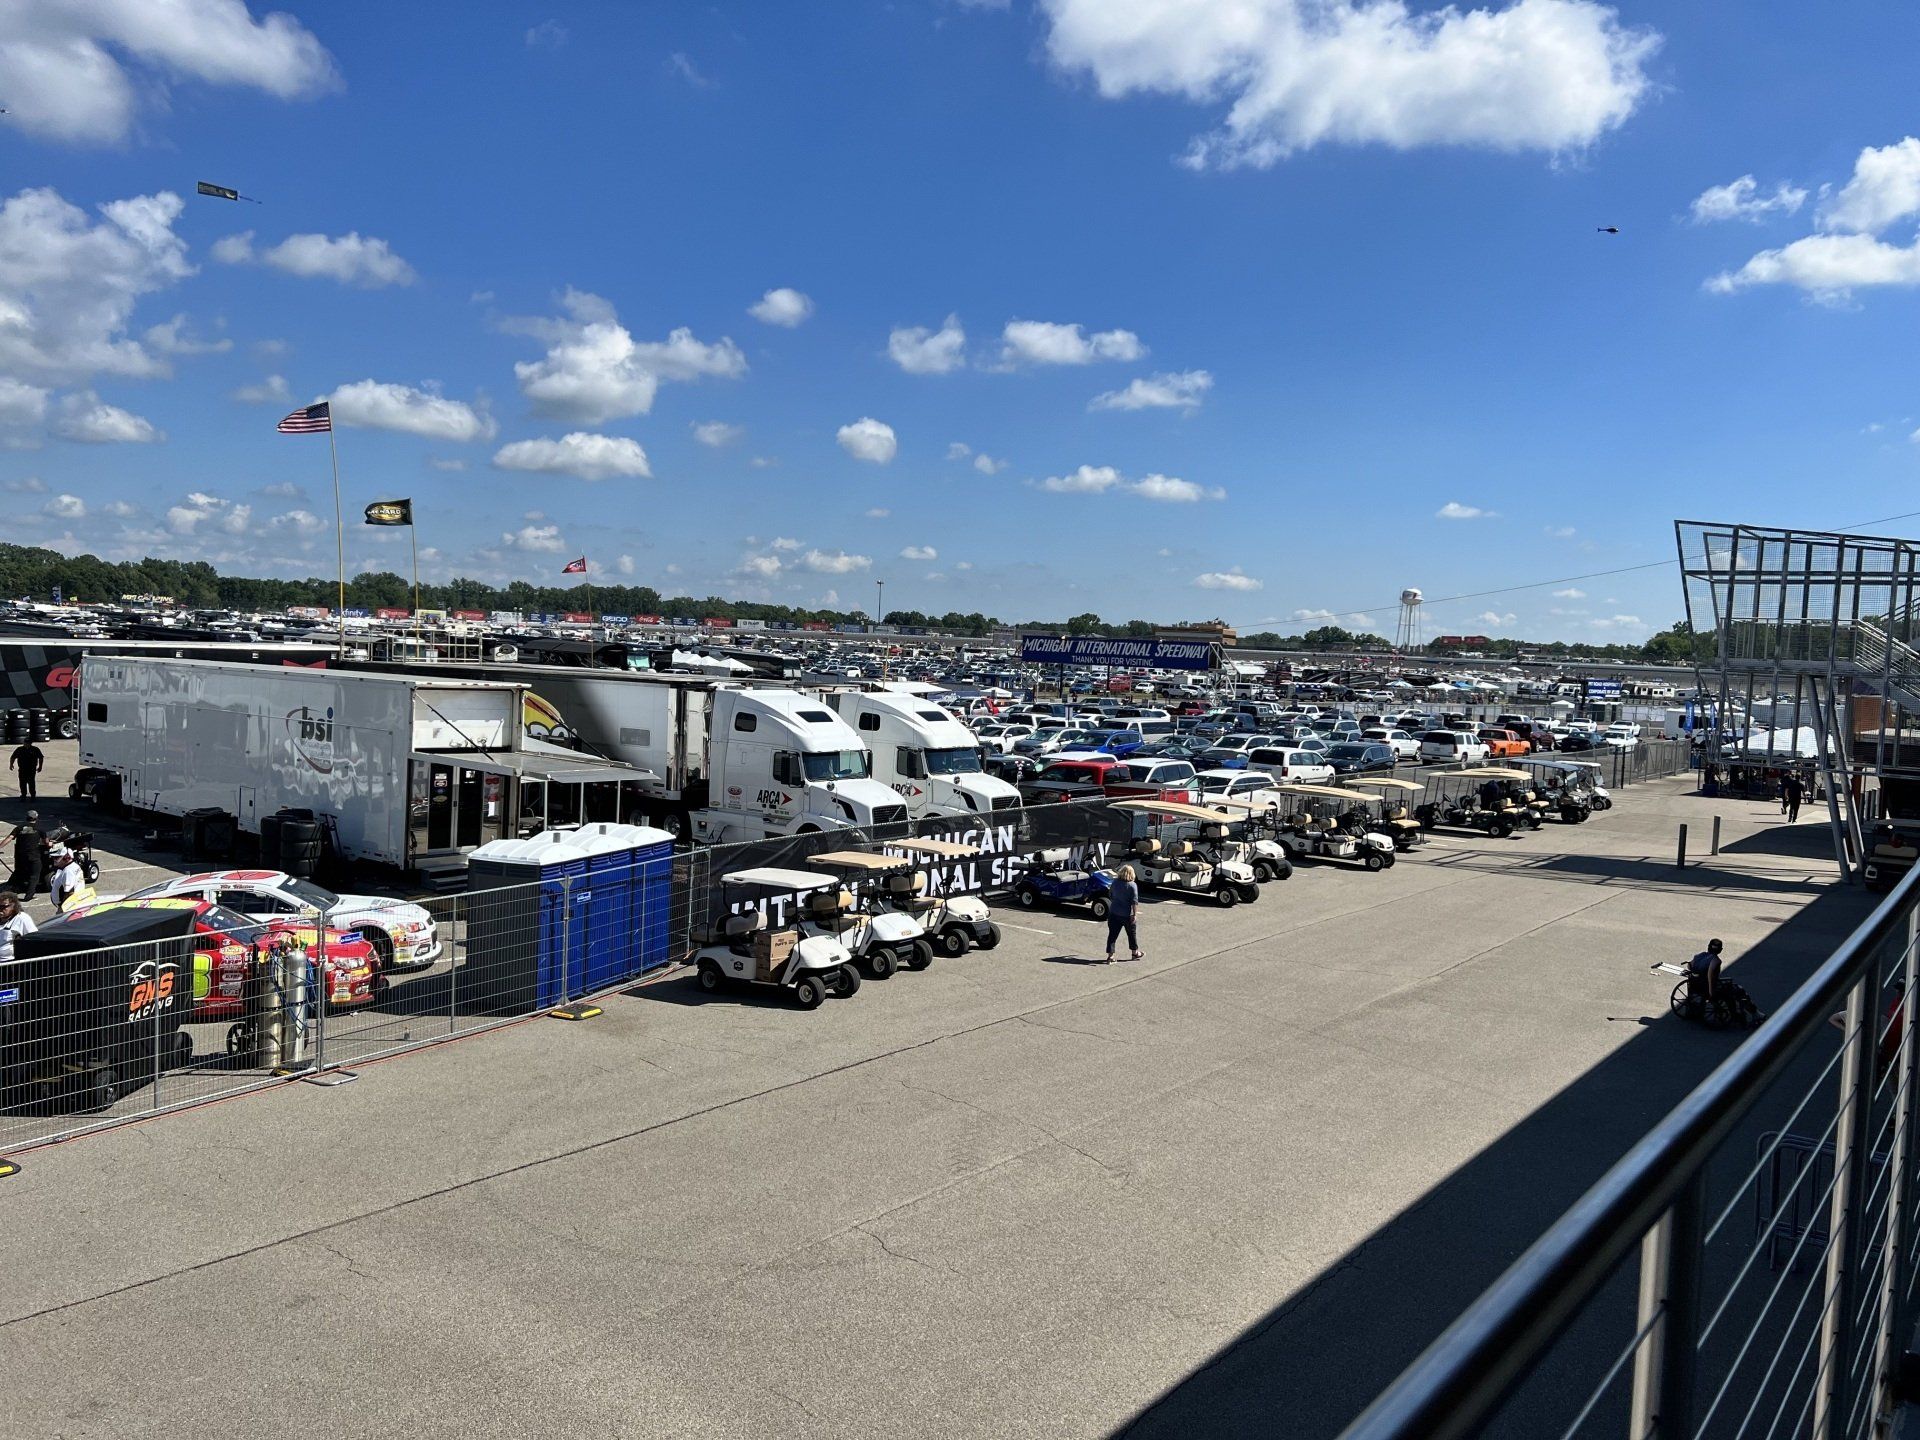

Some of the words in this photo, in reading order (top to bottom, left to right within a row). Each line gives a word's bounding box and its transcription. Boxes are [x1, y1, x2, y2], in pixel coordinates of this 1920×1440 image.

[1023, 638, 1072, 653] MICHIGAN
[1075, 642, 1151, 657] INTERNATIONAL
[1154, 643, 1209, 659] SPEEDWAY
[1072, 655, 1093, 664] THANK
[1095, 657, 1110, 665] YOU
[1110, 658, 1124, 666] FOR
[1125, 658, 1154, 667] VISITING
[301, 706, 334, 743] bsi
[756, 789, 781, 805] ARCA
[129, 971, 174, 1011] GMS
[128, 995, 174, 1022] RACING
